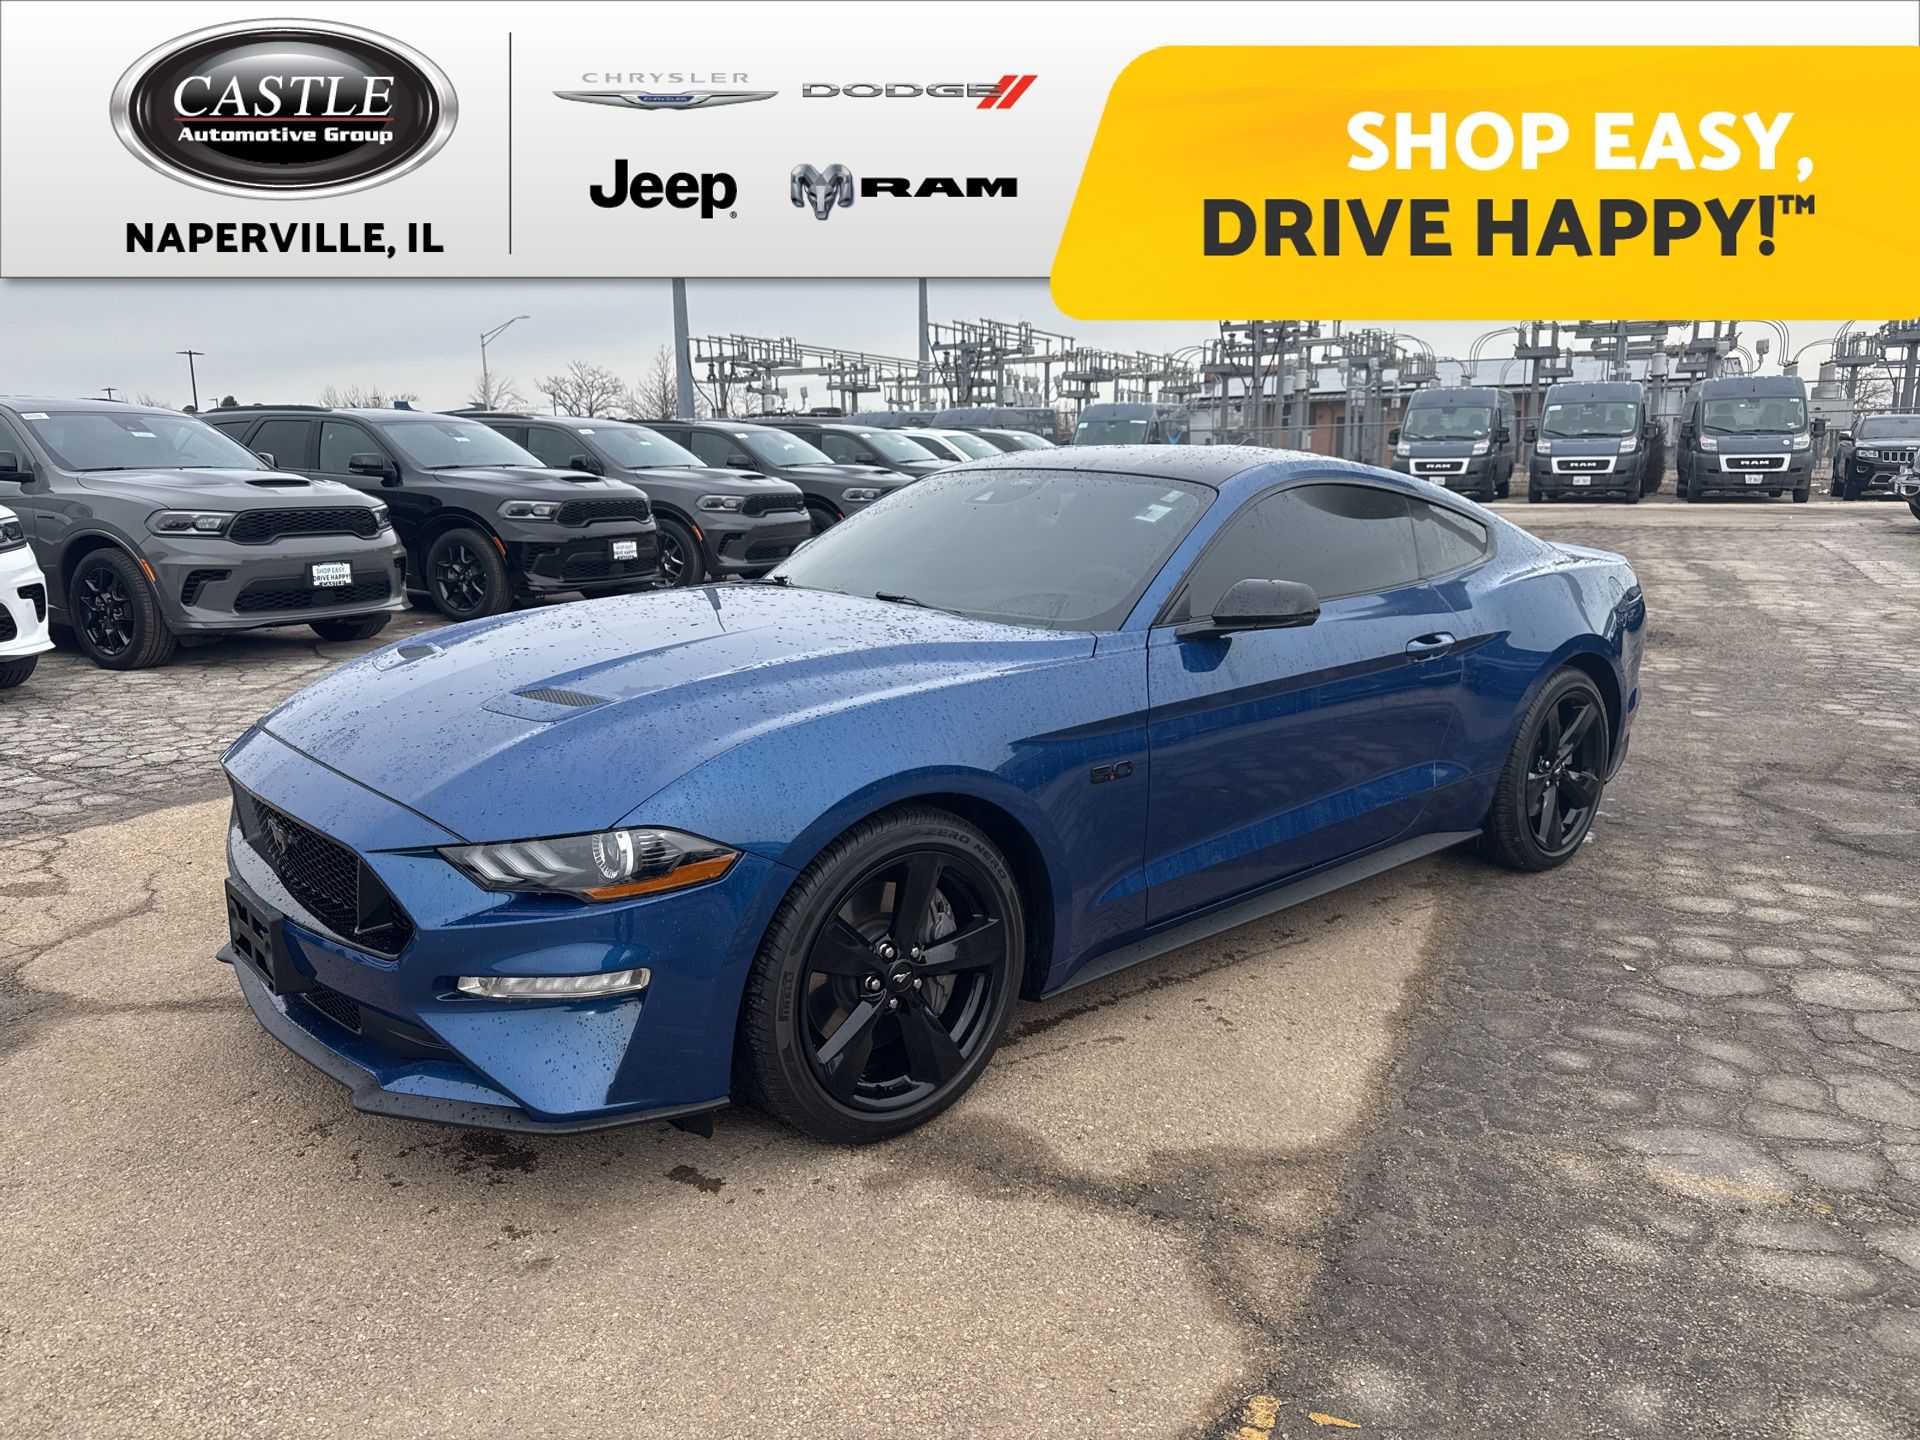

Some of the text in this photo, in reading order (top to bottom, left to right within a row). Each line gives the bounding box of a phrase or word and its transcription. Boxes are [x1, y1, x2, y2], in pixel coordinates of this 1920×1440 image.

[1090, 760, 1133, 784] 5.0
[924, 827, 970, 844] ZERO
[778, 970, 795, 1022] PIRELLI
